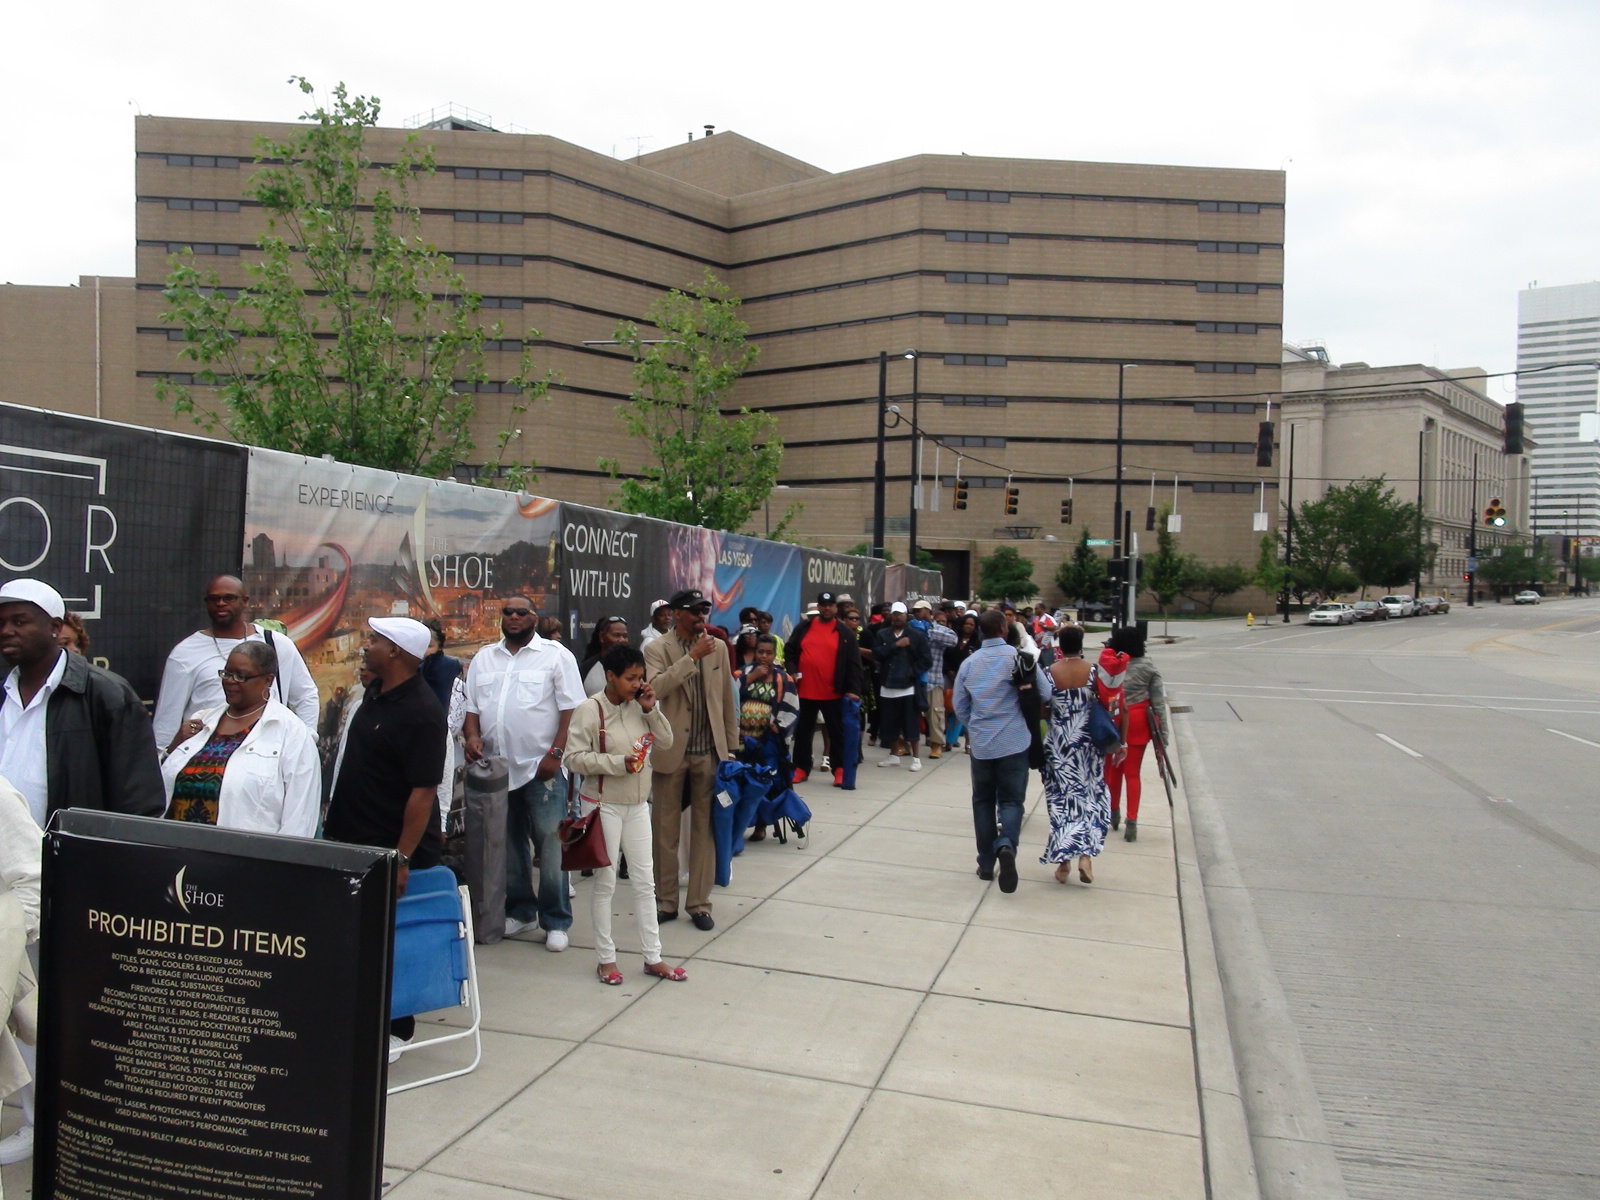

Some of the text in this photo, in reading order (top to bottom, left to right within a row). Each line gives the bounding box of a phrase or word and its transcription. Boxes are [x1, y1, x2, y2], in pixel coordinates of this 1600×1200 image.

[298, 484, 394, 514] EXPERIENCE
[431, 537, 449, 551] THE
[563, 522, 638, 558] CONNECT
[718, 550, 753, 567] LAS VEGAS
[429, 553, 494, 589] SHOE
[807, 557, 855, 586] GO MOBILE.
[569, 568, 631, 598] WITH US
[185, 883, 198, 891] THE
[184, 890, 225, 908] SHOE
[88, 908, 307, 959] PROHIBITED ITEMS
[137, 948, 176, 959] BACKPACKS
[184, 953, 222, 964] OVERSIZED
[224, 958, 242, 966] BAGS
[119, 963, 138, 972] FOOD
[146, 967, 181, 978] BEVERAGE
[161, 960, 194, 970] COOLERS
[202, 965, 226, 973] LIQUID
[227, 967, 272, 979] CONTAINERS
[130, 984, 168, 995] FIREWORKS
[176, 990, 200, 998] OTHER
[201, 992, 245, 1004] PROJECTILES
[152, 978, 223, 992] ILLEGAL SUBSTANCES
[138, 1003, 164, 1013] TABLETS
[202, 1011, 239, 1022] E-READERS
[169, 999, 192, 1007] VIDEO
[193, 1001, 233, 1012] EQUIPMENT
[123, 1020, 142, 1029] LARGE
[144, 1023, 169, 1033] CHAINS
[178, 1027, 210, 1037] STUDDED
[212, 1031, 250, 1042] BRACELETS
[141, 1013, 156, 1022] TYPE
[200, 1021, 251, 1033] POCKETKNIVES
[128, 1039, 147, 1047] LASER
[148, 1042, 181, 1052] POINTERS
[189, 1047, 221, 1058] AEROSOL
[222, 1051, 242, 1060] CANS
[168, 1035, 190, 1044] TENTS
[198, 1039, 238, 1050] UMBRELLAS
[134, 1048, 161, 1059] DEVICES
[114, 1055, 133, 1064] LARGE
[193, 1066, 216, 1076] STICKS
[224, 1071, 256, 1081] STICKERS
[116, 1063, 129, 1072] PETS
[158, 1071, 184, 1081] SERVICE
[215, 1079, 227, 1087] SEE
[229, 1081, 254, 1090] BELOW
[104, 1079, 124, 1089] OTHER
[125, 1084, 143, 1093] ITEMS
[154, 1089, 188, 1100] REQUIRED
[199, 1096, 221, 1105] EVENT
[223, 1099, 265, 1111] PROMOTERS
[124, 1074, 243, 1099] TWO-WHEELED MOTORIZED DEVICES
[115, 1108, 248, 1136] USED DURING TONIGHT'S PERFORMANCE.
[203, 1113, 219, 1121] AND
[220, 1115, 268, 1128] ATMOSPHERIC
[270, 1122, 300, 1132] EFFECTS
[302, 1126, 317, 1134] MAY
[318, 1128, 327, 1136] BE
[85, 1131, 89, 1139] &
[91, 1134, 113, 1145] VIDEO
[85, 1117, 98, 1126] WILL
[99, 1120, 106, 1128] BE
[108, 1122, 141, 1136] PERMITTED
[150, 1131, 173, 1141] SELECT
[175, 1137, 197, 1146] AREAS
[198, 1140, 224, 1150] DURING
[226, 1144, 263, 1156] CONCERTS
[275, 1151, 288, 1160] THE
[290, 1154, 311, 1163] SHOE.
